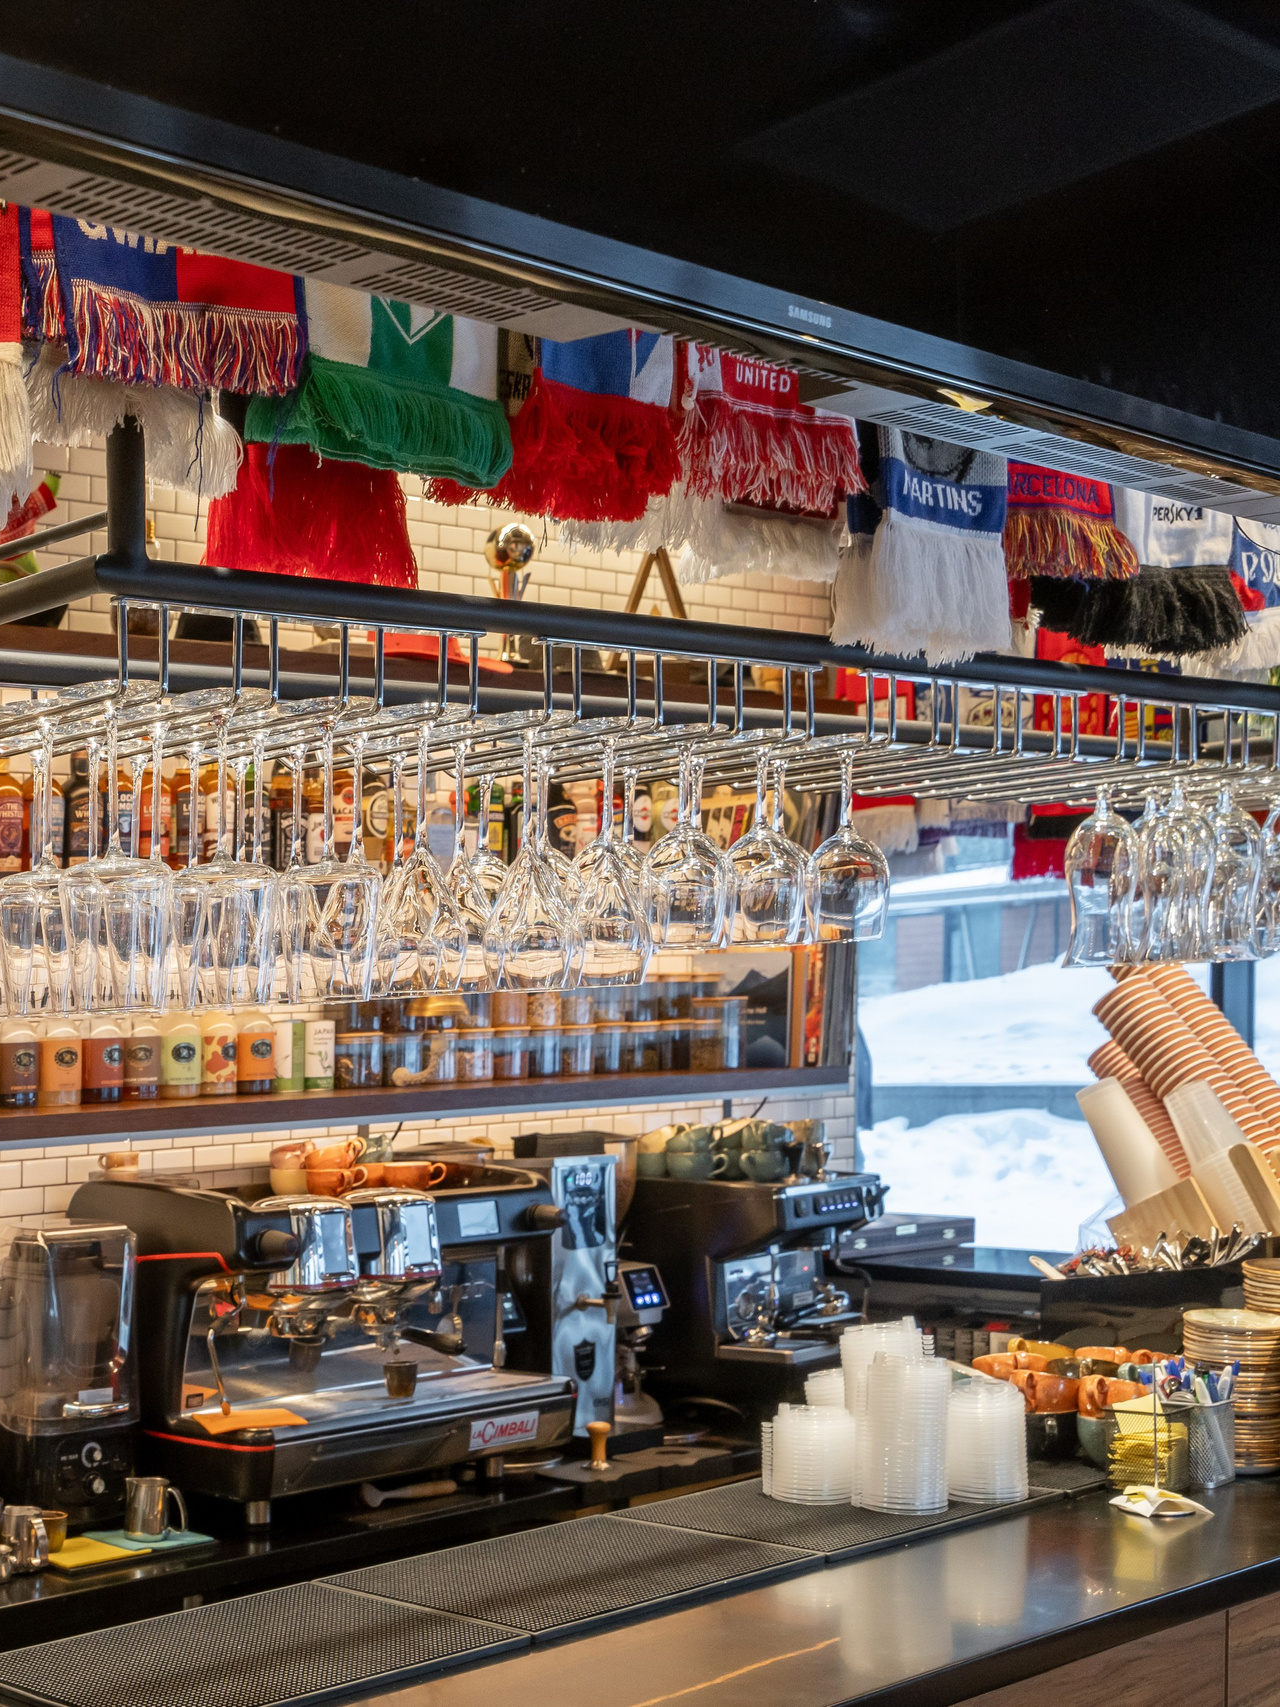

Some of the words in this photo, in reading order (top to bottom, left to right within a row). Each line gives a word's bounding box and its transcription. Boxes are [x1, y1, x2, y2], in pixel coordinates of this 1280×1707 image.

[788, 305, 832, 328] SAMSUNG
[735, 363, 791, 394] UNITED
[1007, 470, 1100, 508] ARCELONA
[575, 1171, 593, 1187] 100
[481, 1420, 537, 1444] CIMBALI
